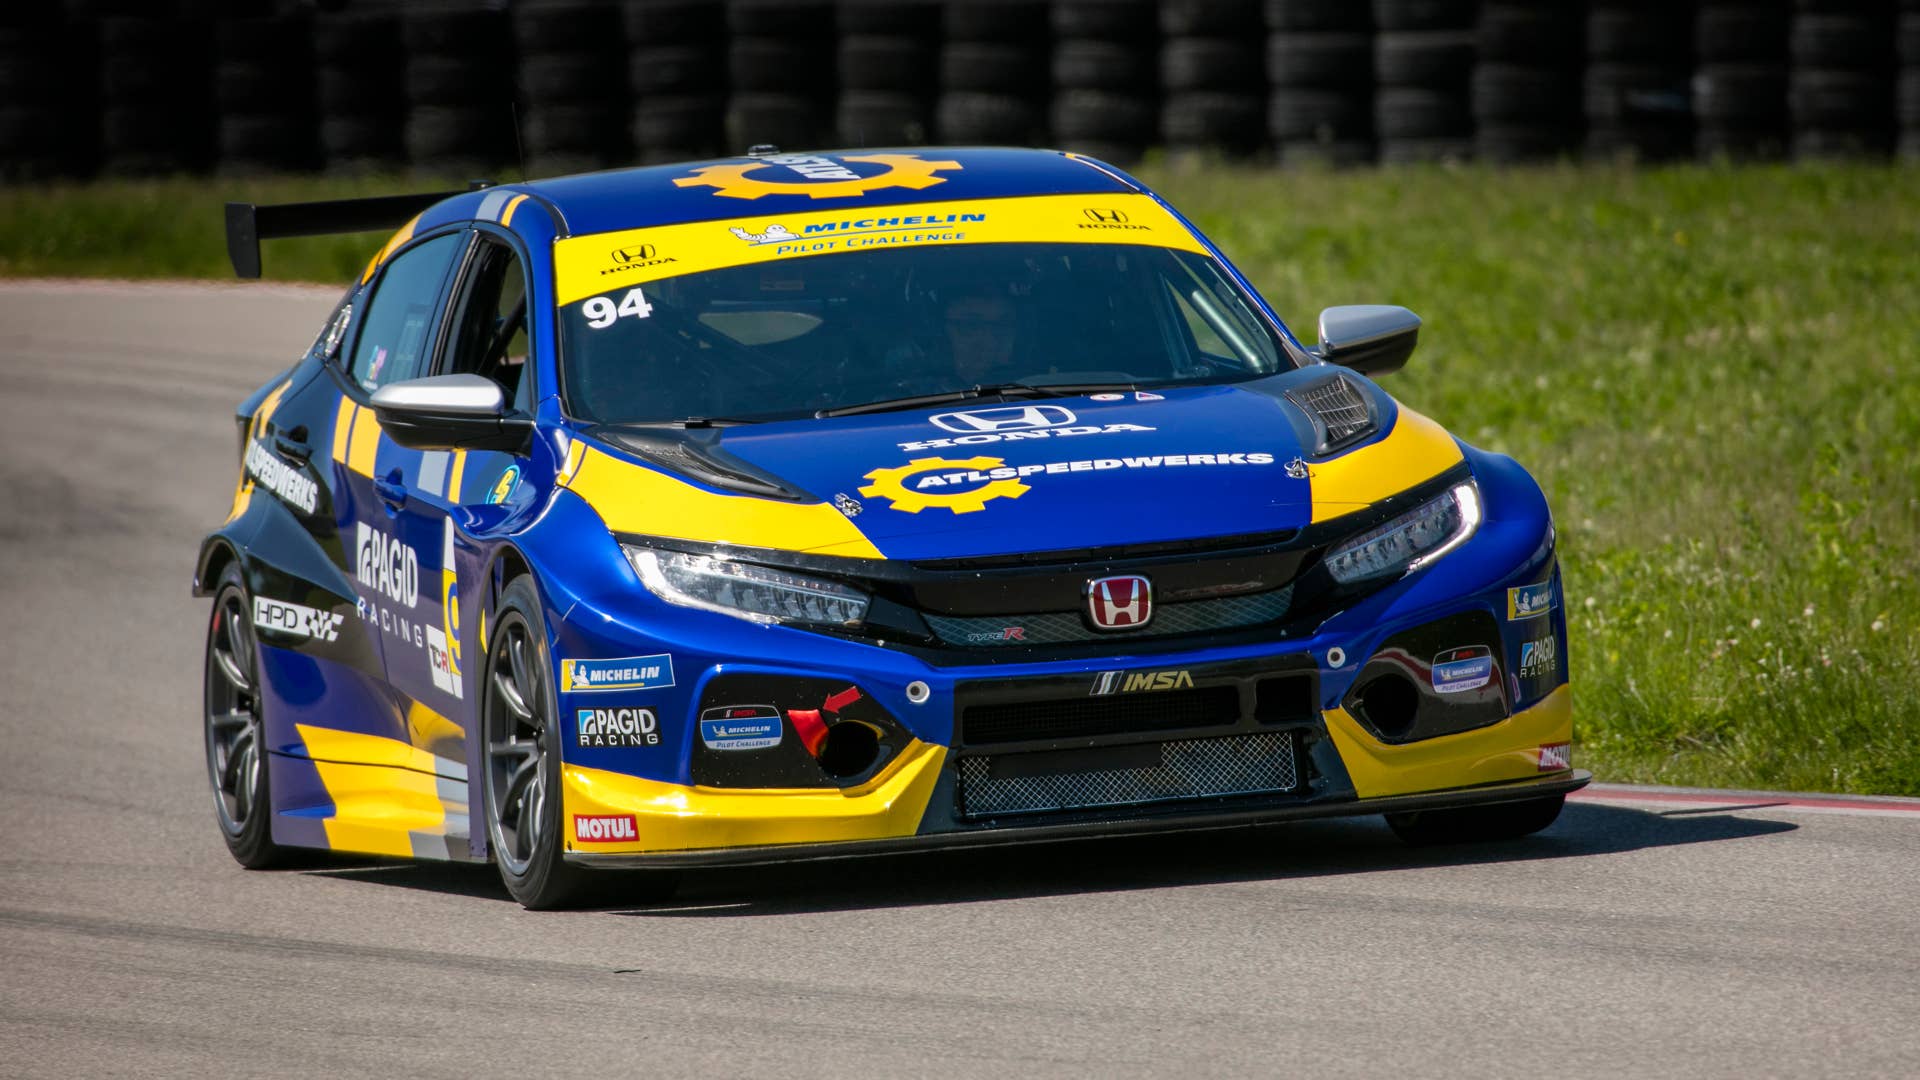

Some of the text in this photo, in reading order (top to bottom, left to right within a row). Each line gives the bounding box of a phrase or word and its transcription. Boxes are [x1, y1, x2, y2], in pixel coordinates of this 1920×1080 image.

[803, 213, 986, 234] MICHELIN
[1076, 223, 1153, 231] HONDA
[776, 232, 967, 255] PILOT CHALLENGE
[600, 257, 677, 276] HONDA
[581, 287, 653, 330] 94
[897, 423, 1158, 451] HONDA
[371, 527, 419, 609] PAGID
[256, 600, 299, 629] HPD
[356, 596, 424, 649] RACING
[1533, 635, 1555, 666] PAGID
[589, 666, 661, 682] MICHELIN
[1519, 659, 1556, 678] RACING
[1122, 670, 1194, 692] IMSA
[595, 708, 657, 735] PAGID
[727, 725, 771, 734] MICHELIN
[580, 733, 659, 747] RACING
[577, 817, 636, 839] MOTUL
